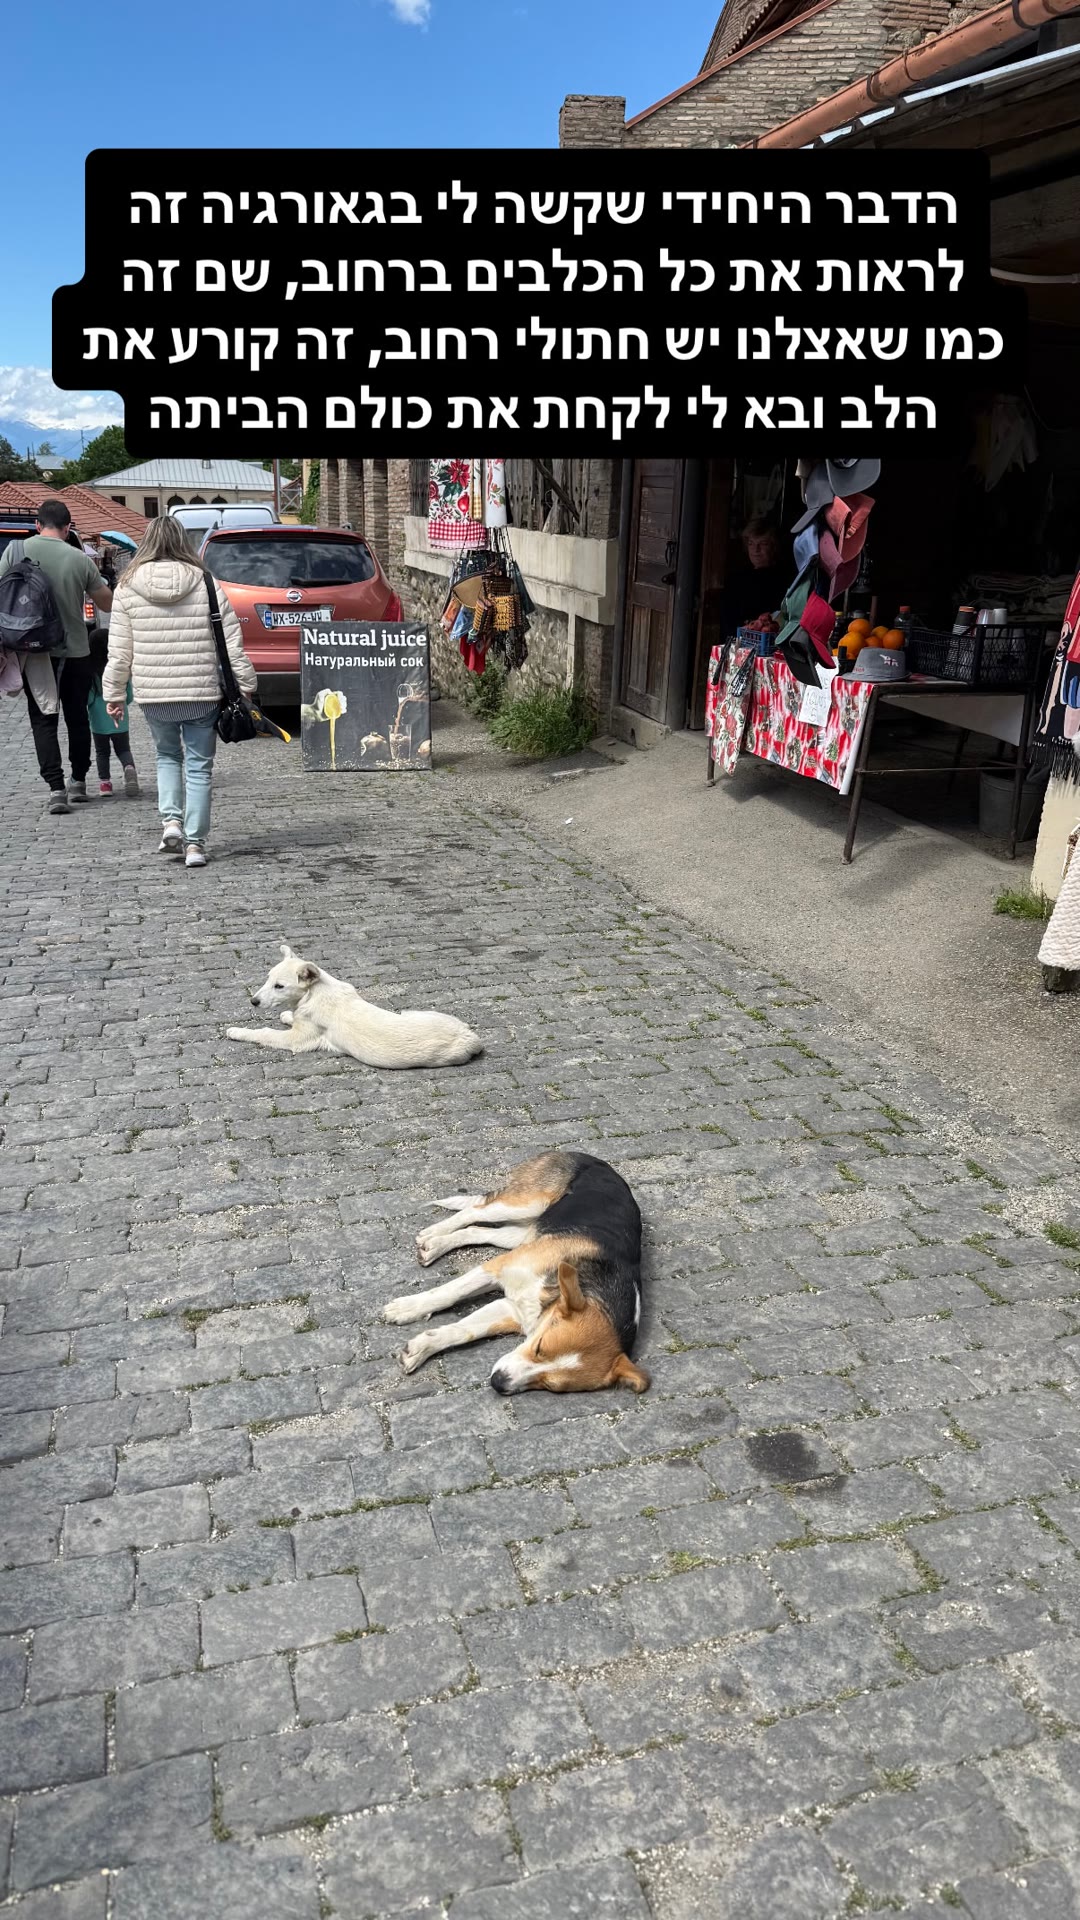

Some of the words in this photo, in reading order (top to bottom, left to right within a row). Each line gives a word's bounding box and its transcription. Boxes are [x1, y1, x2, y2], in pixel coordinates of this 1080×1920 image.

[303, 628, 377, 647] Natural
[381, 629, 427, 651] juice
[305, 652, 397, 670] Натуральный
[400, 655, 424, 667] сок
